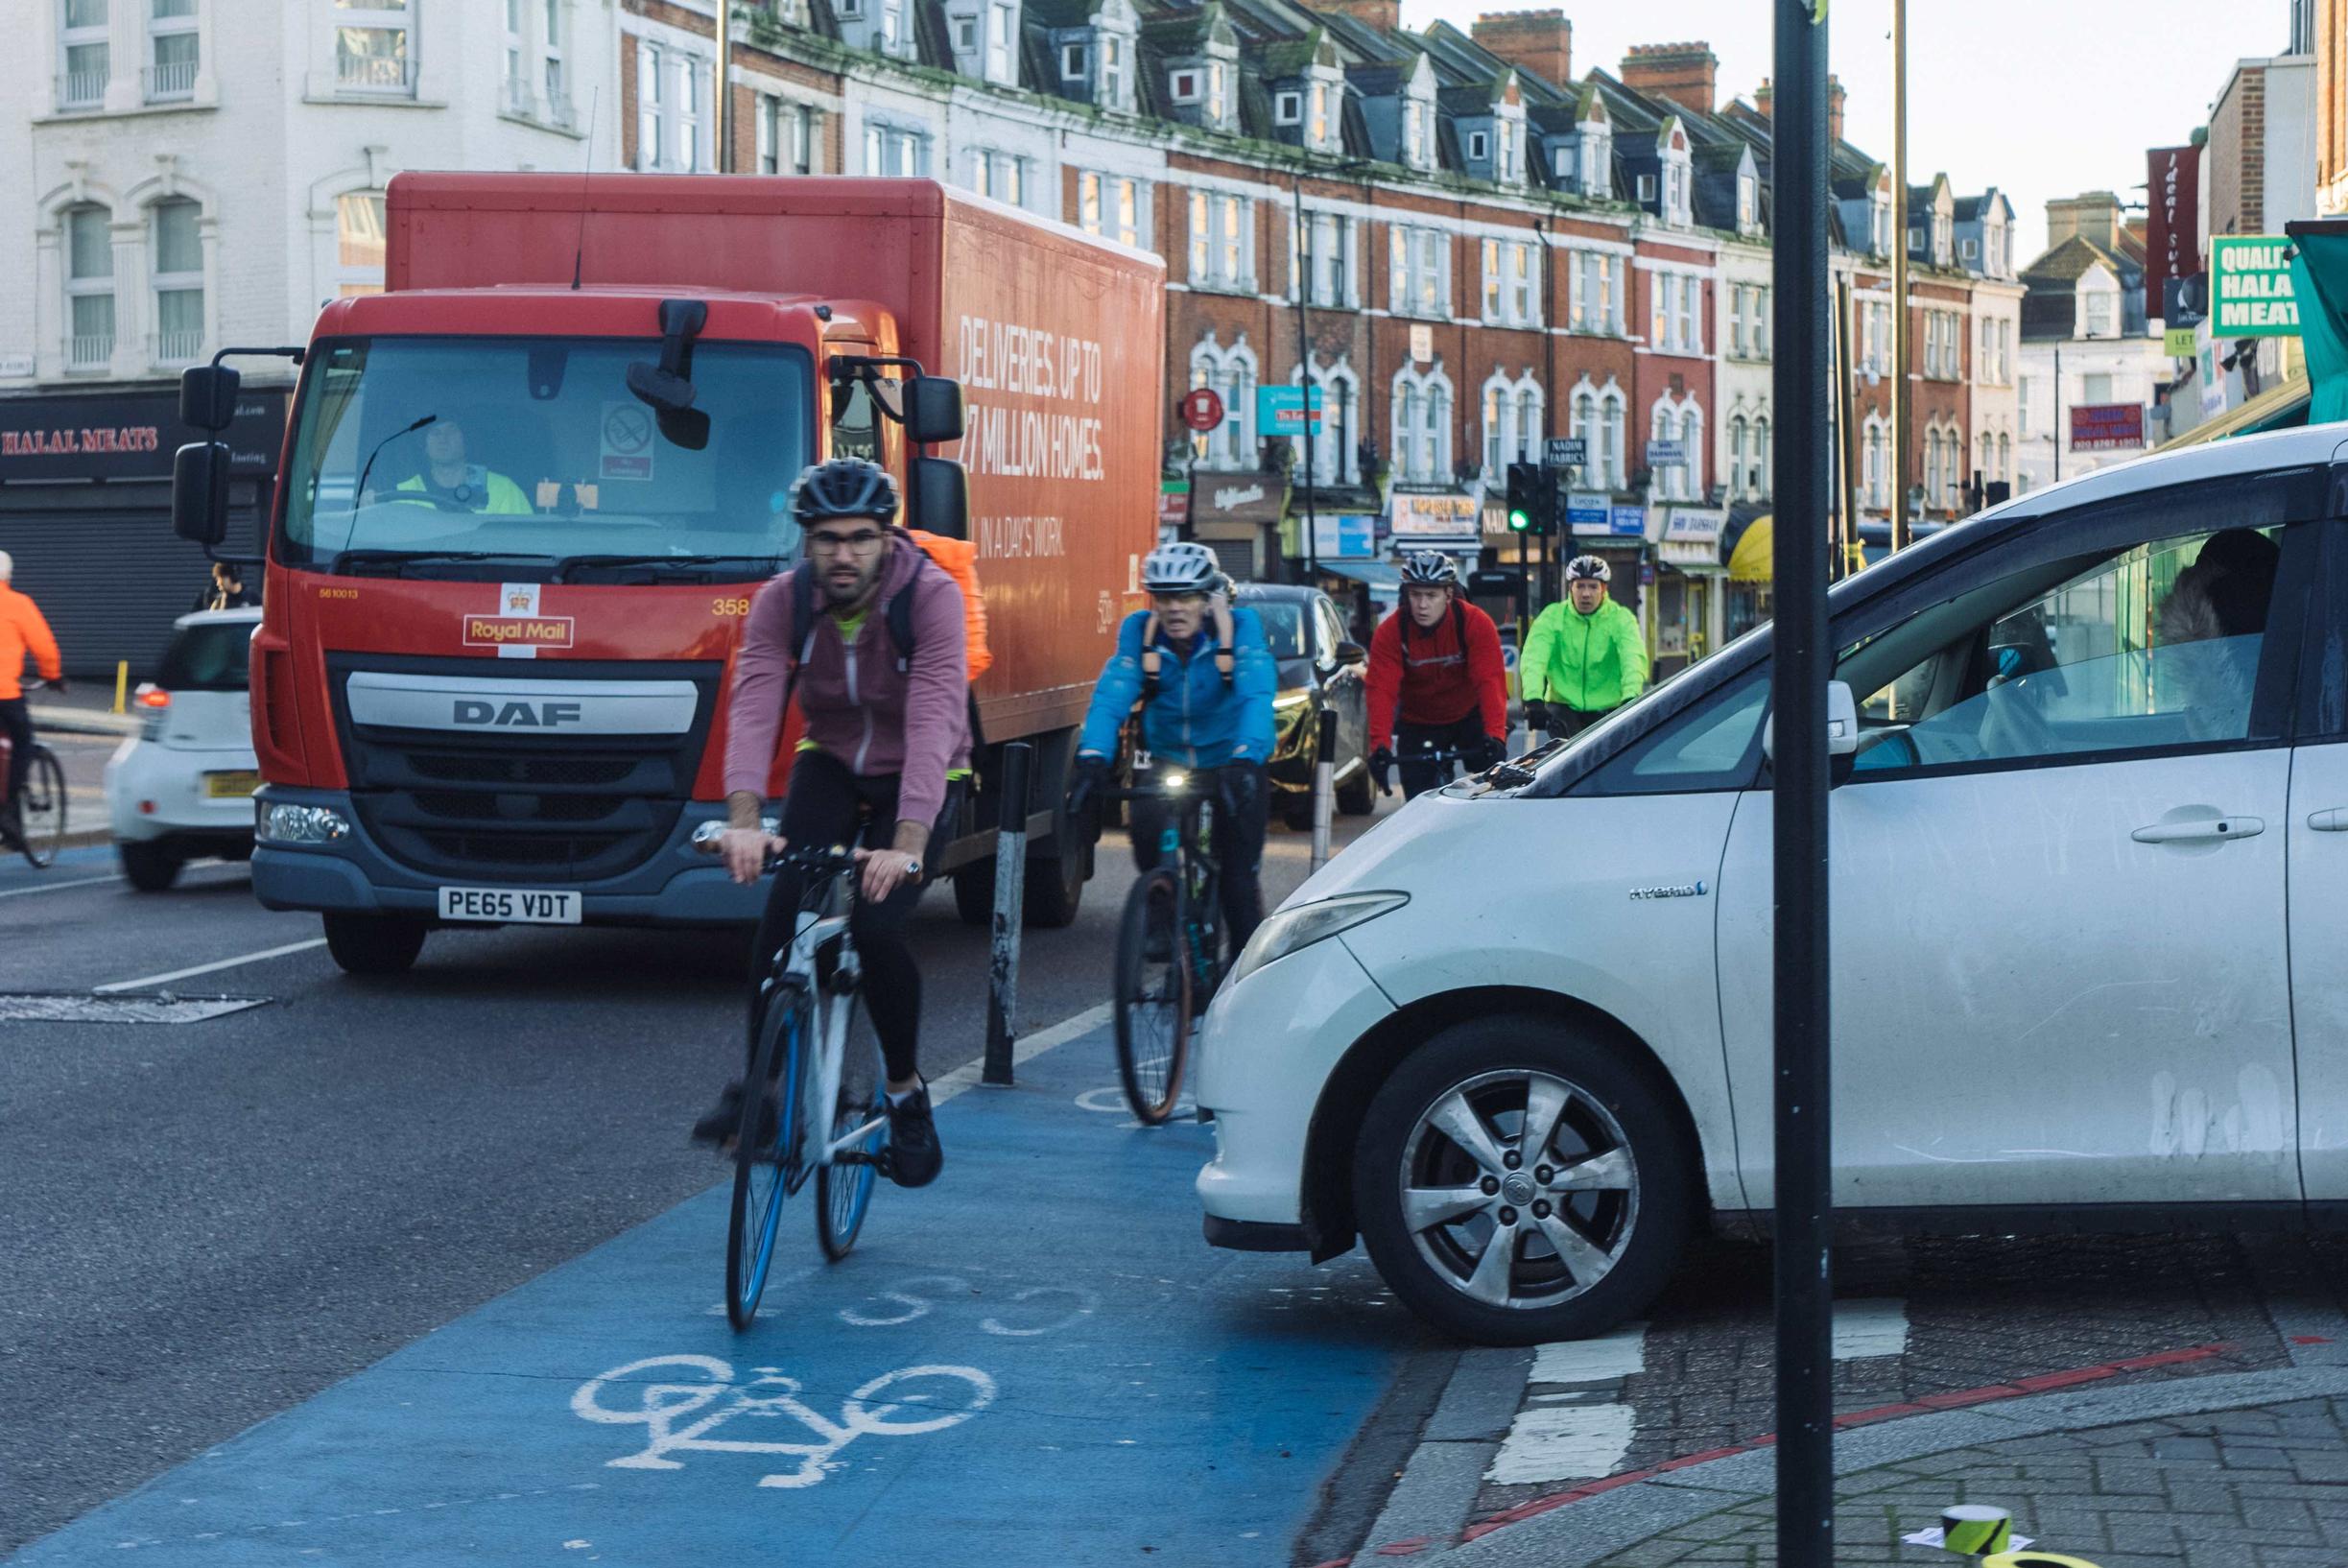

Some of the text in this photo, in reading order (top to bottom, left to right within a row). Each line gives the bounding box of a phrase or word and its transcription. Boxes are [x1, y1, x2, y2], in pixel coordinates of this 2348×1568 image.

[2221, 273, 2295, 297] HALA
[2175, 334, 2194, 346] LET
[960, 315, 1102, 404] DELIVERIES. UP TO
[2, 426, 158, 455] HALAL MEATS
[982, 404, 1048, 478] MILLION
[1051, 414, 1105, 481] HOMES.
[1552, 440, 1583, 452] NADIM
[1549, 451, 1585, 464] FABRICS
[981, 517, 992, 558] IN
[994, 518, 1003, 558] A
[471, 620, 565, 642] Royal Mail
[453, 701, 581, 726] DAF
[448, 891, 570, 919] PE65 VDT
[1629, 886, 1696, 900] HYBRID
